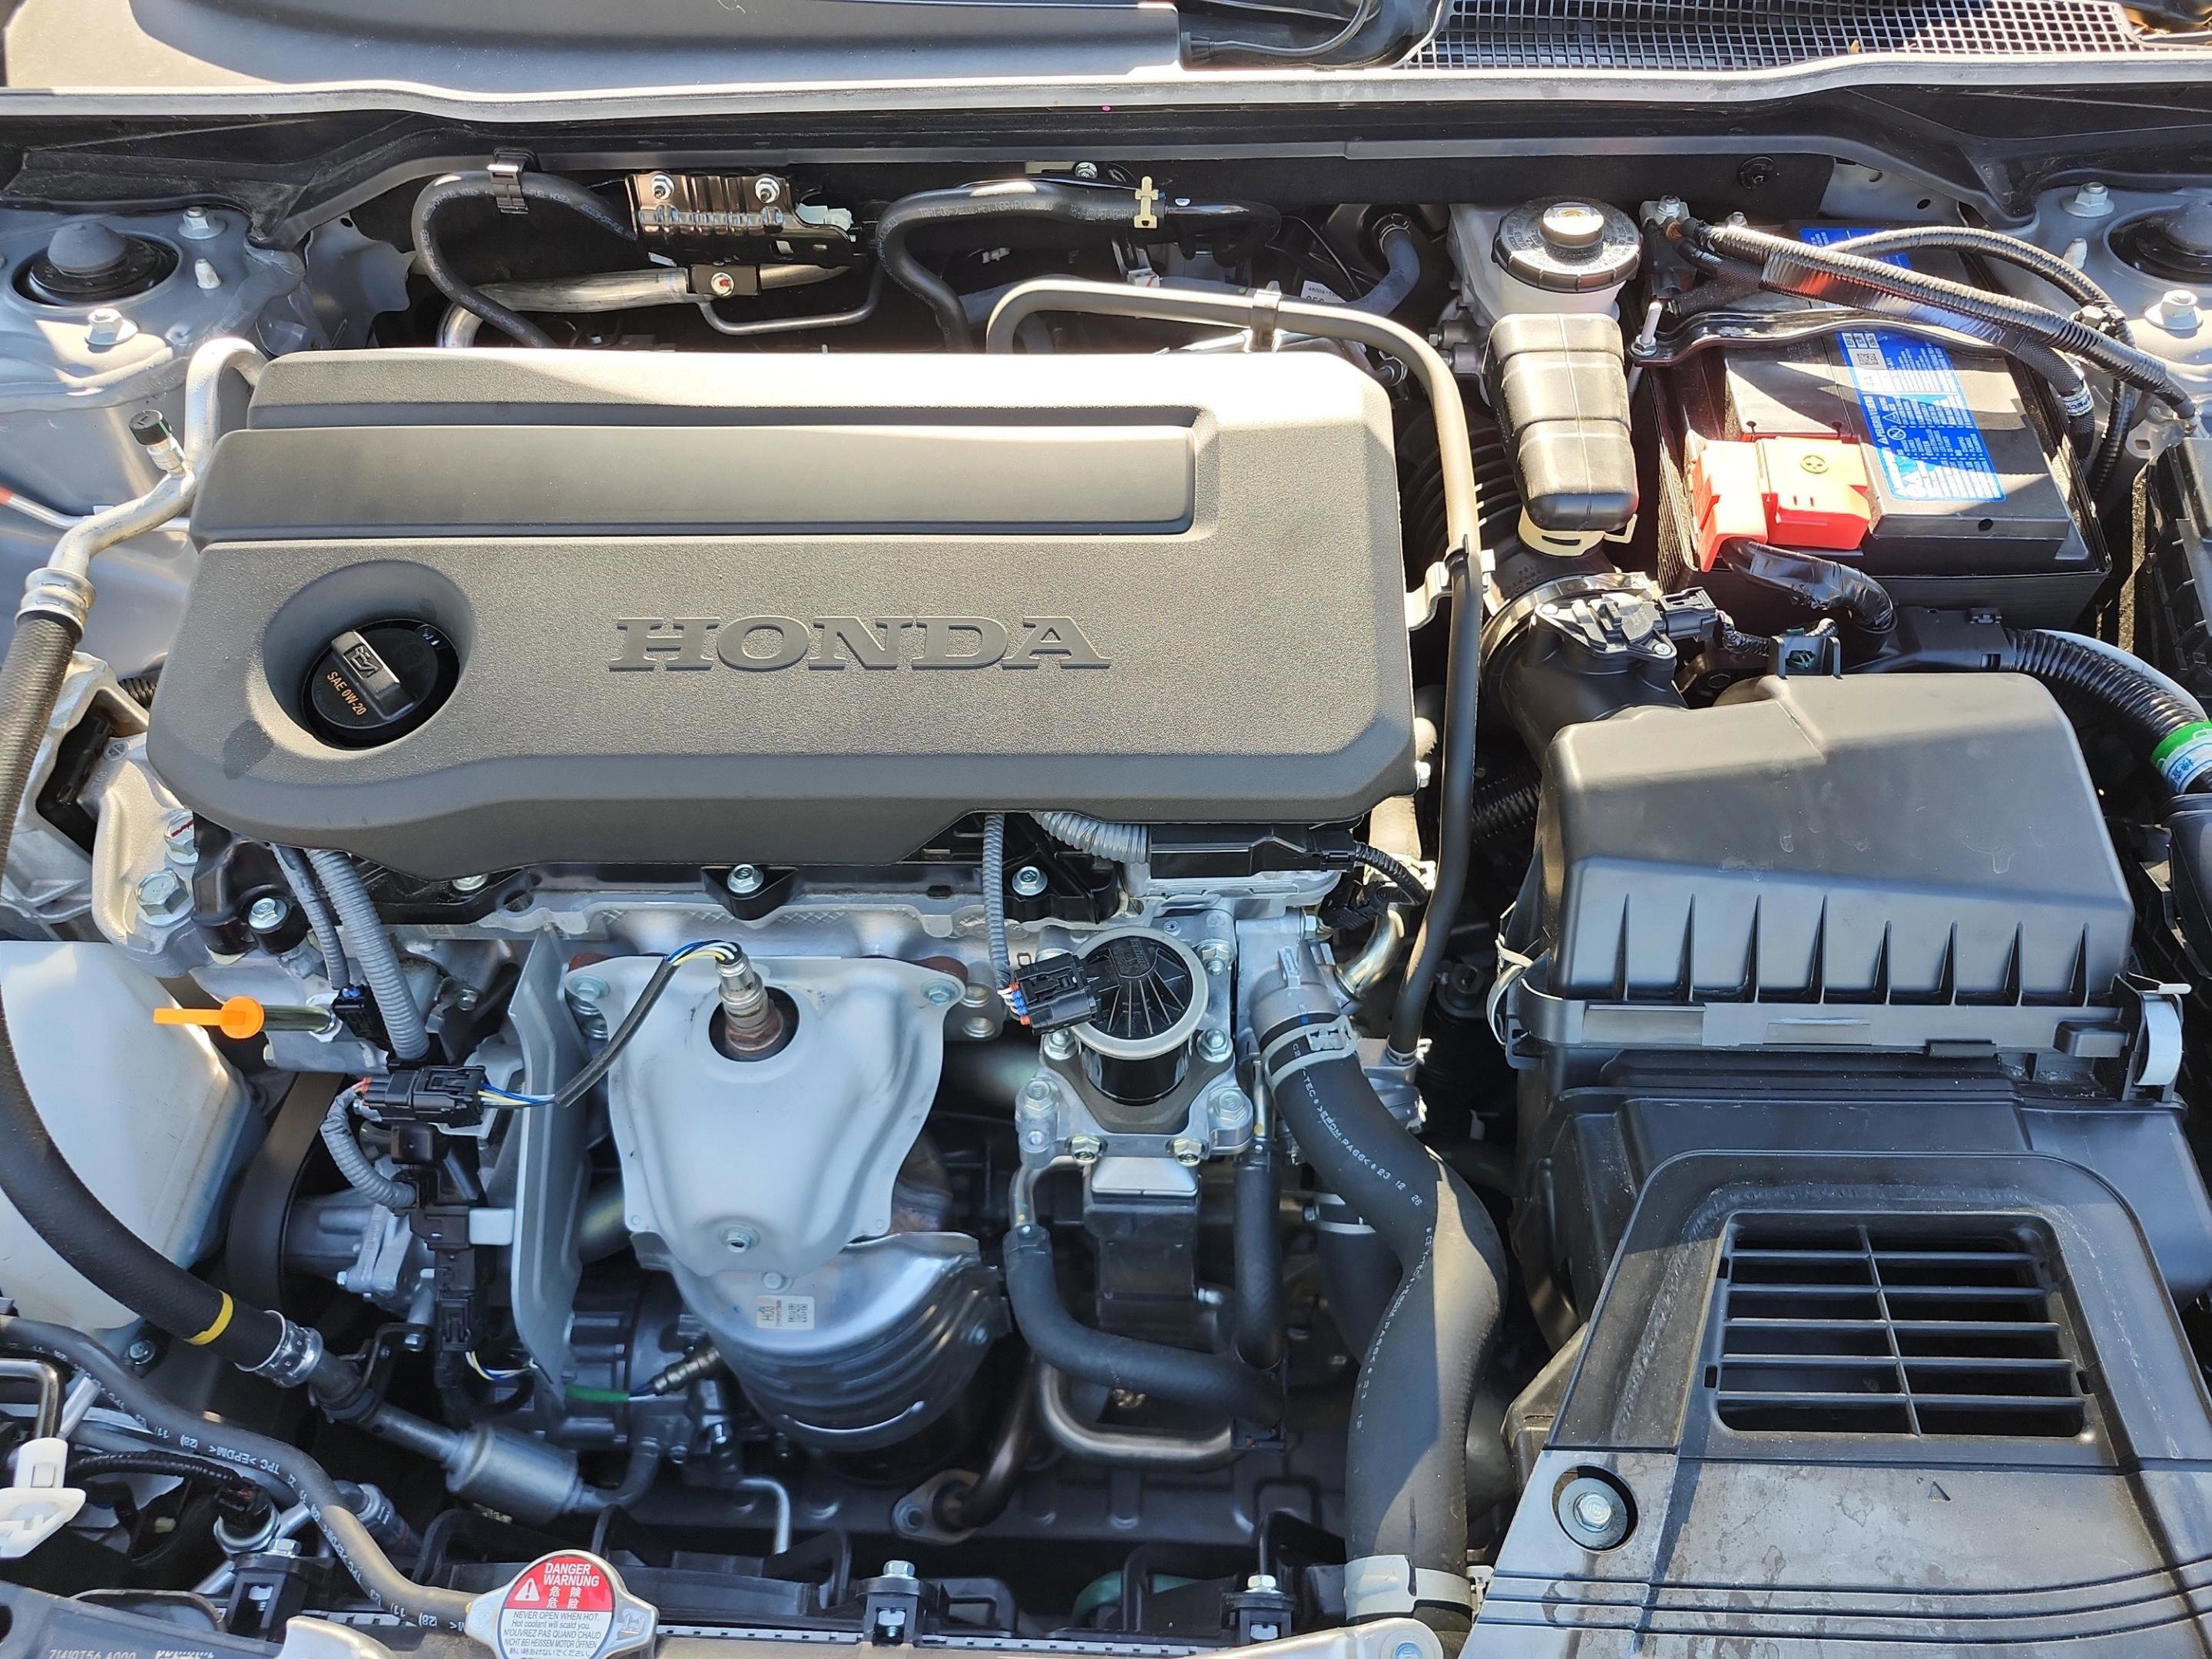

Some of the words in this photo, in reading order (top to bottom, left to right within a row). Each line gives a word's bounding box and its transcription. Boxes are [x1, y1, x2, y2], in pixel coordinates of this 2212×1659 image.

[608, 615, 1112, 671] HONDA
[326, 671, 348, 691] SAE
[341, 689, 367, 716] 0W-20
[1301, 1066, 1316, 1098] -TEC
[1376, 1167, 1391, 1180] 23
[208, 1444, 257, 1465] >EPDM<
[260, 1462, 280, 1475] TPC
[545, 1562, 591, 1575] DANGER
[544, 1574, 600, 1587] WARNUNG
[513, 1611, 538, 1619] NEVER
[539, 1611, 559, 1620] OPEN
[560, 1612, 581, 1621] WHEN
[583, 1613, 600, 1621] HOT.
[512, 1619, 523, 1628] Hot
[524, 1620, 548, 1628] coolant
[559, 1621, 577, 1629] scald
[552, 1630, 577, 1638] QUAND
[504, 1637, 521, 1647] NICHT
[522, 1638, 531, 1647] BEI
[531, 1639, 554, 1647] HEISSEM
[555, 1640, 575, 1648] MOTOR
